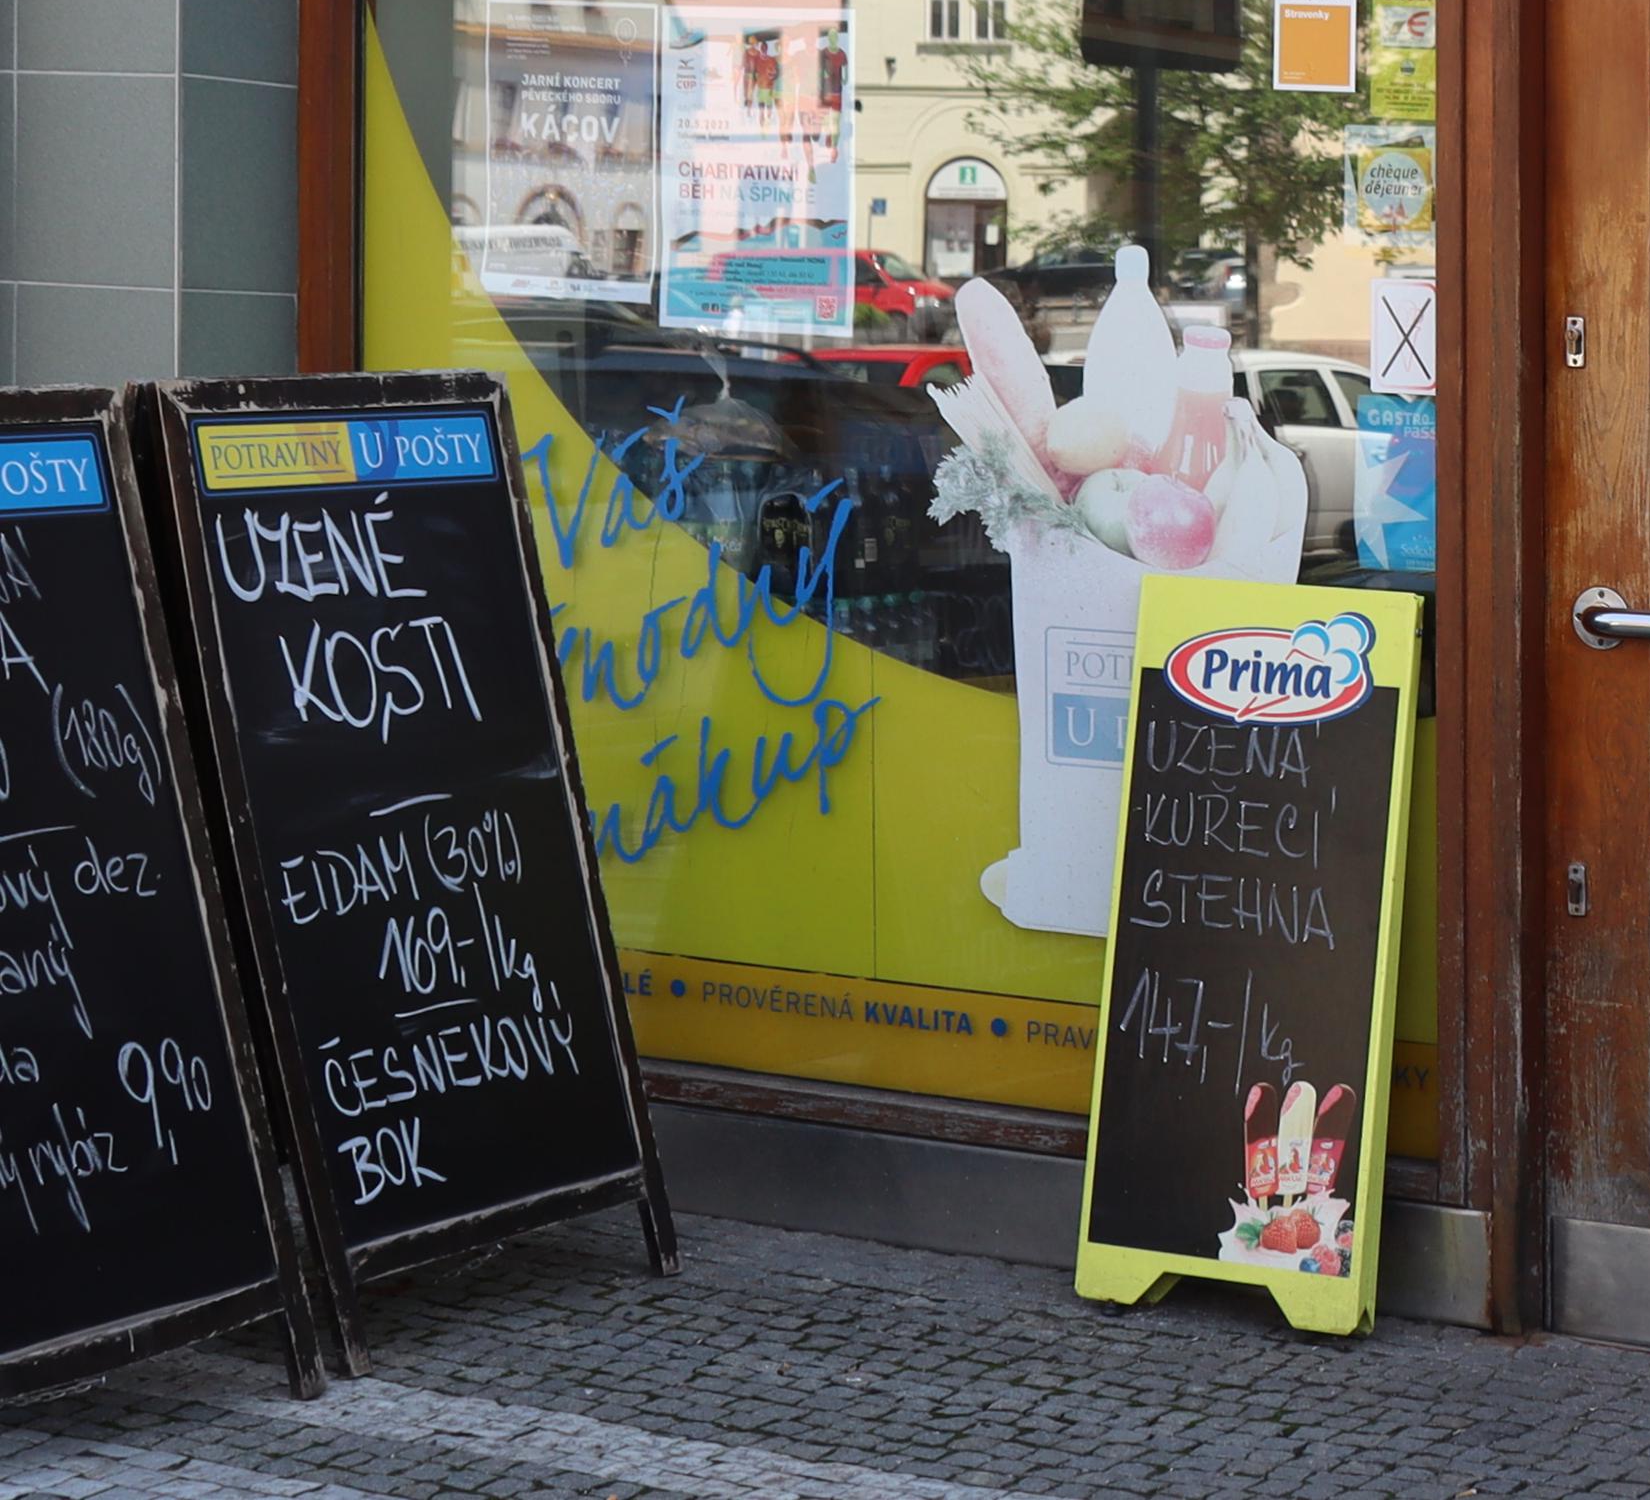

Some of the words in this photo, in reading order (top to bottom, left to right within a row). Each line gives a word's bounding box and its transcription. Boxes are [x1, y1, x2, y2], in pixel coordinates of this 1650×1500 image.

[521, 72, 561, 88] JARNÍ
[563, 76, 622, 90] KONCERT
[521, 88, 583, 103] PĚVECKÉHO
[679, 180, 714, 200] BĚH
[720, 187, 746, 202] NA
[1369, 162, 1418, 184] chèque
[1367, 408, 1430, 426] GASTRO
[211, 439, 342, 472] POTRAVINY
[358, 431, 384, 469] U
[394, 427, 482, 468] POŠTY
[0, 453, 89, 496] OŠTY
[520, 395, 706, 570] Váš
[215, 491, 428, 601] UZENÉ
[278, 615, 483, 744] KOSTI
[1202, 647, 1334, 700] Prima
[1064, 705, 1096, 747] U
[1129, 869, 1335, 951] STEHNA
[702, 980, 854, 1021] PROVĚRENÁ
[863, 1001, 973, 1037] KVALITA
[1025, 1019, 1098, 1051] PRAV
[337, 1116, 448, 1205] BOK
